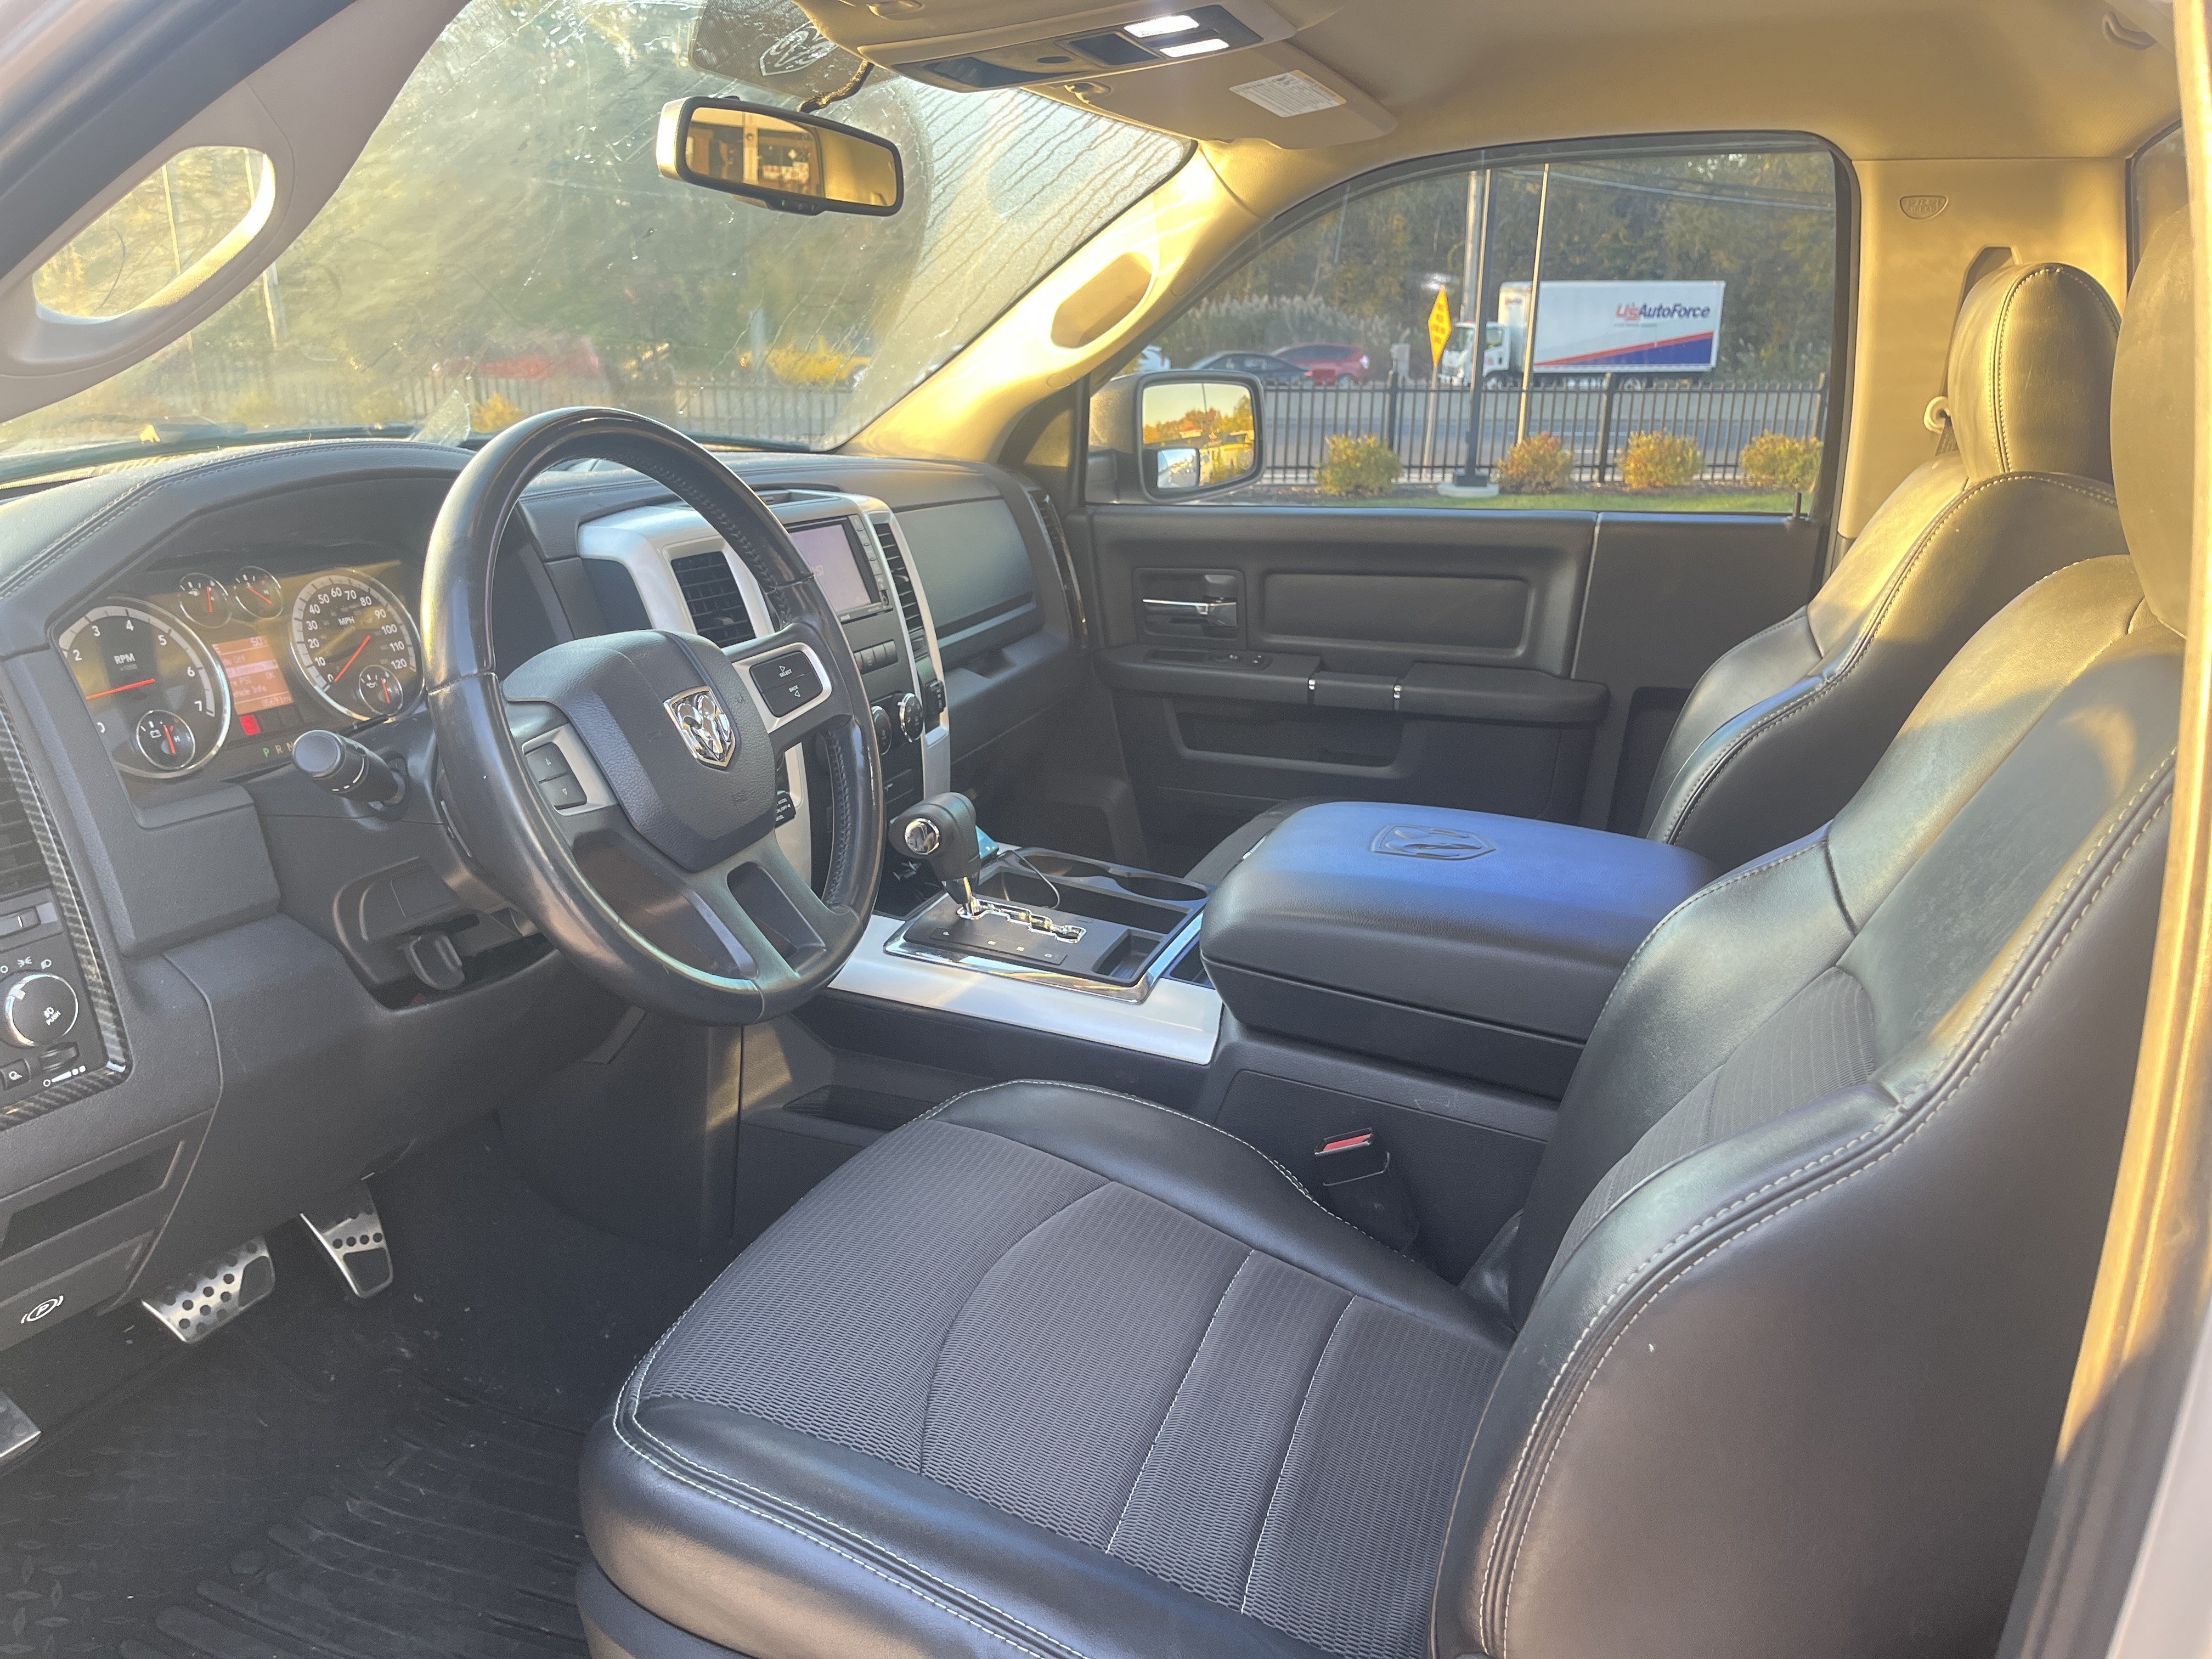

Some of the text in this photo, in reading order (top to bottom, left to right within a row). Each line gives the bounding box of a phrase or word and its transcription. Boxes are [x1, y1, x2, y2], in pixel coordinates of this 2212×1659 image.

[331, 587, 342, 597] 60
[344, 590, 357, 600] 70
[318, 594, 330, 604] 50
[360, 596, 372, 606] 80
[309, 604, 320, 614] 40
[374, 608, 386, 619] 90
[126, 619, 134, 631] 4
[306, 620, 318, 630] 30
[338, 616, 356, 627] MPH
[91, 625, 100, 636] 3
[381, 624, 397, 635] 100
[157, 634, 167, 646] 5
[308, 637, 320, 648] 20
[390, 641, 405, 652] 110
[72, 649, 82, 661] 2
[114, 653, 136, 665] RPM
[314, 656, 326, 667] 10
[391, 658, 407, 670] 120
[187, 666, 195, 677] 6
[779, 669, 792, 678] SELECT
[194, 700, 202, 712] 7
[263, 747, 269, 758] P
[275, 744, 283, 754] R
[46, 1011, 61, 1025] PUSH
